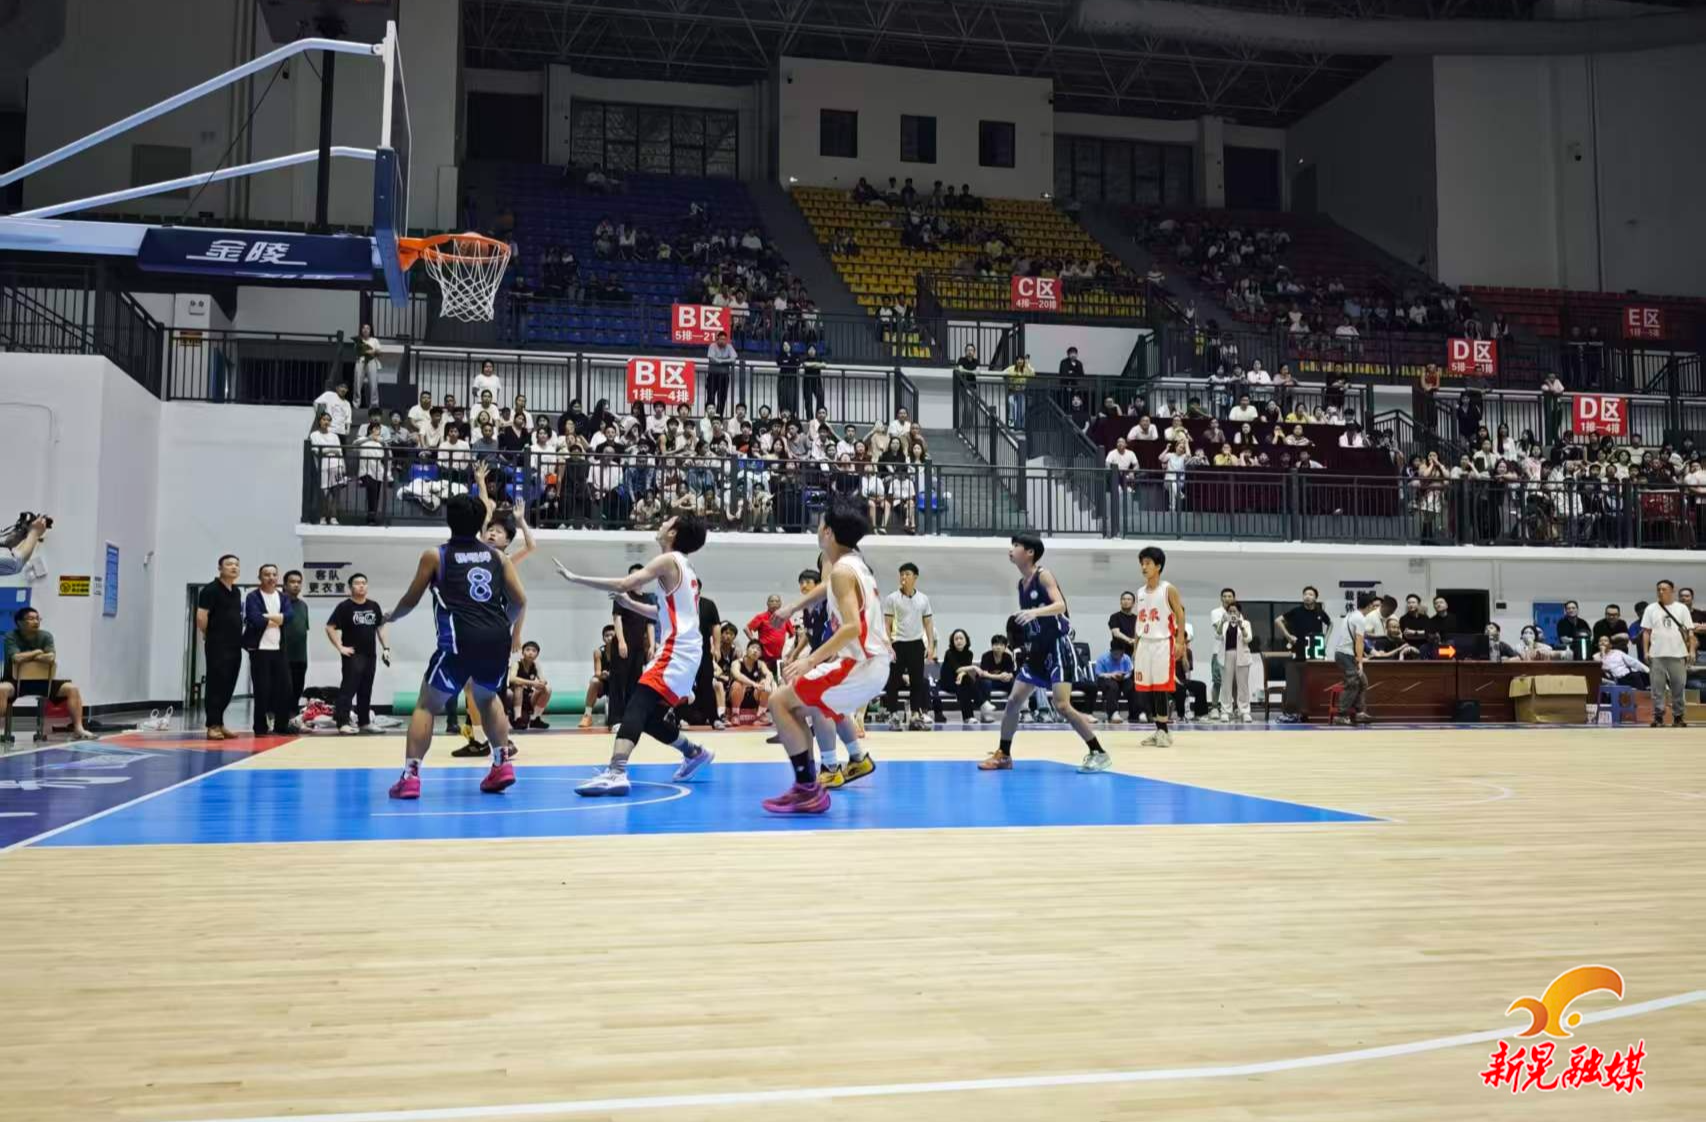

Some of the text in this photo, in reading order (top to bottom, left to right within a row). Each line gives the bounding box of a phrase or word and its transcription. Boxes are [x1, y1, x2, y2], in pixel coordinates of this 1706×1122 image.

[187, 239, 307, 266] 金陵
[1018, 277, 1056, 300] C区
[678, 306, 724, 331] B区
[1629, 308, 1661, 328] E区
[1453, 340, 1493, 363] D区
[635, 360, 687, 389] B区
[1580, 397, 1621, 422] D区
[316, 569, 340, 581] 客队
[467, 567, 492, 602] 8
[308, 582, 346, 594] 更衣室
